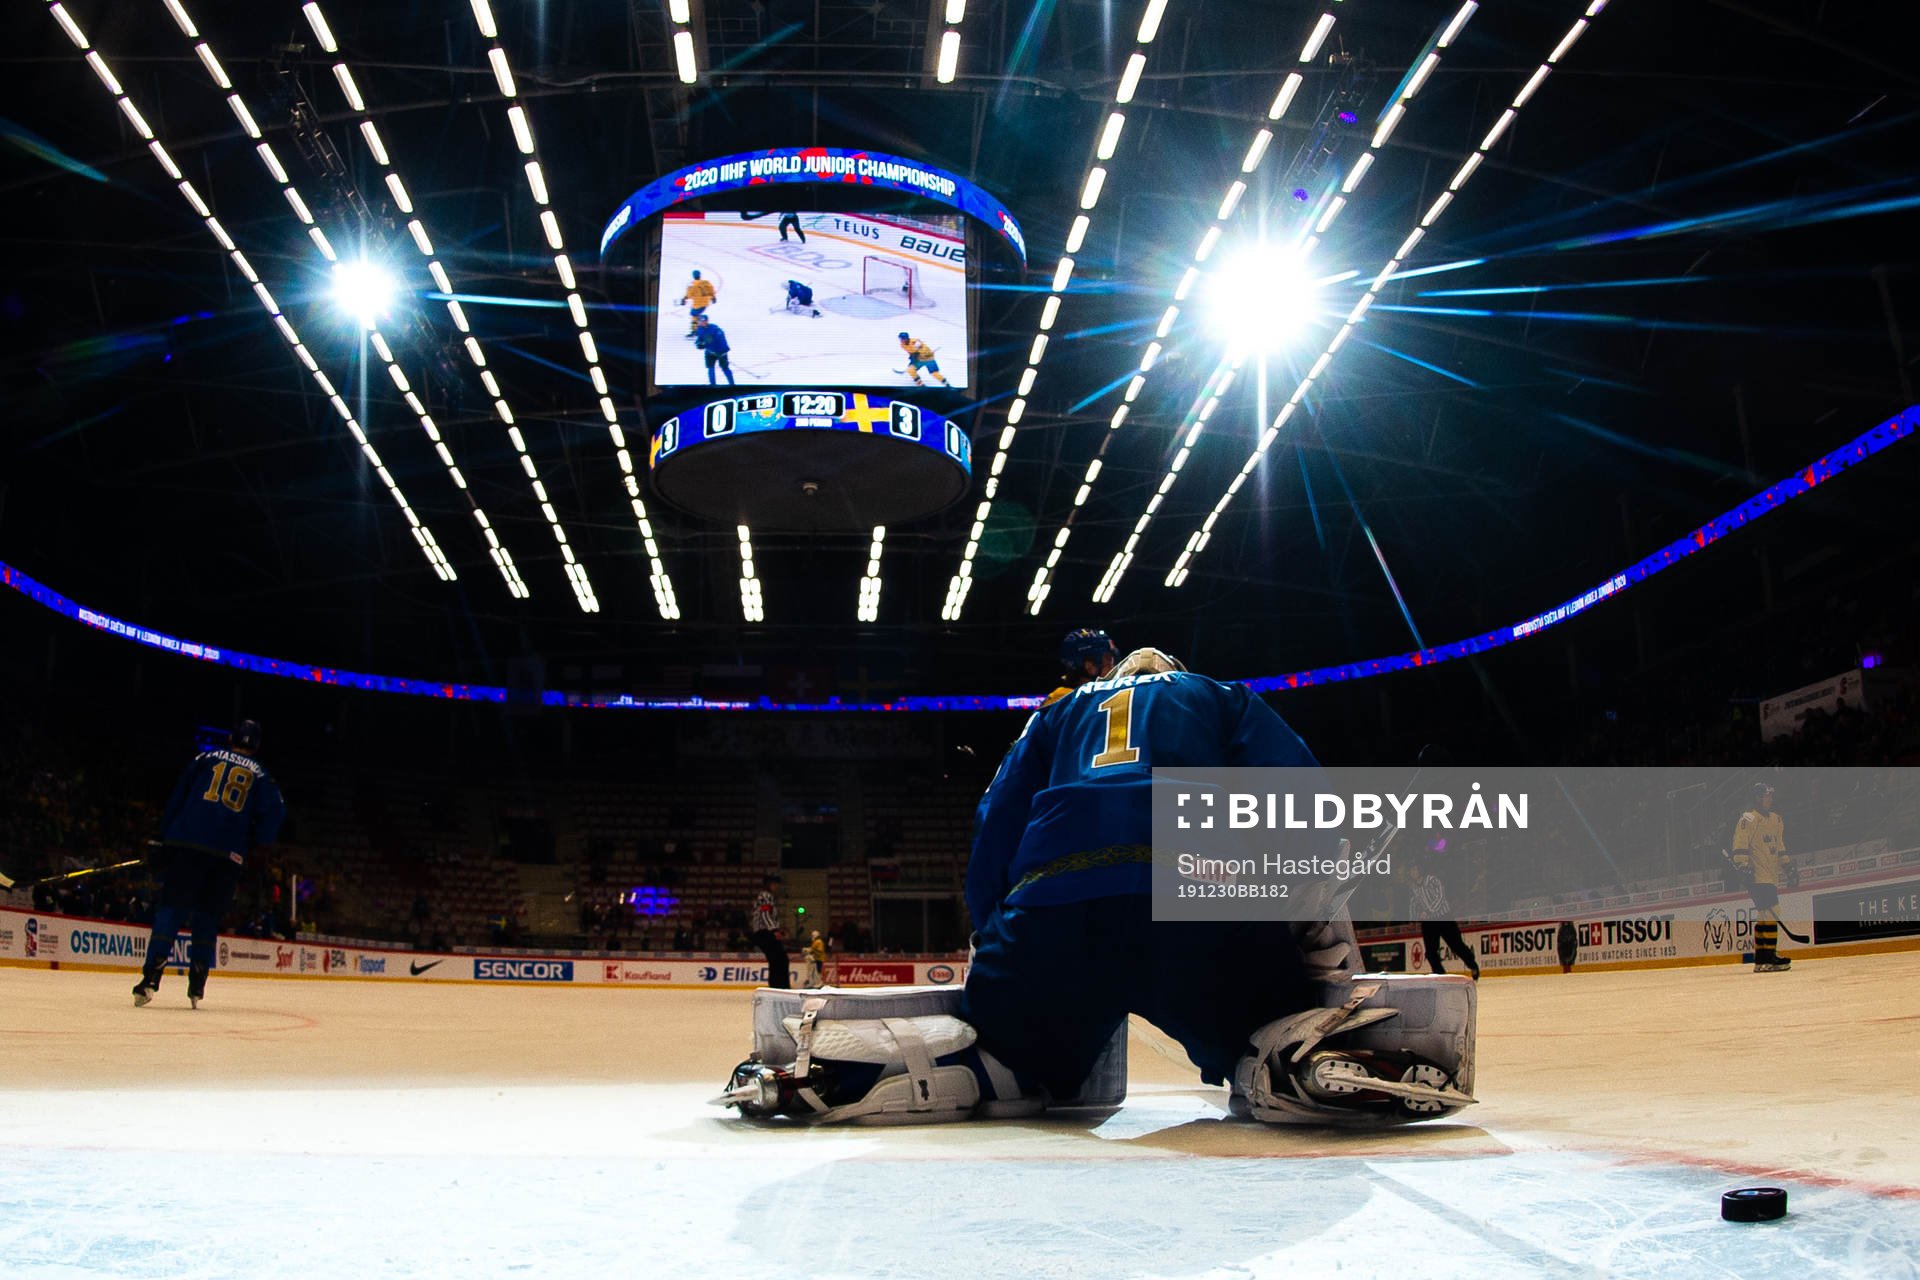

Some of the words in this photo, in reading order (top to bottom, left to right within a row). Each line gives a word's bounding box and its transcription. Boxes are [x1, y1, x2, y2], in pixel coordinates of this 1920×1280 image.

[684, 166, 718, 192] 2020
[720, 161, 748, 182] IIHF
[749, 156, 801, 177] WORLD
[803, 156, 856, 175] JUNIOR
[858, 157, 956, 197] CHAMPIONSHIP
[833, 218, 880, 240] TELUS
[900, 235, 966, 263] Baue
[712, 404, 727, 432] 0
[792, 395, 836, 416] 12:20
[899, 406, 914, 435] 3
[1091, 687, 1140, 768] 1
[203, 761, 255, 813] 18
[1859, 899, 1889, 916] THE
[1898, 894, 1918, 911] KE
[1501, 928, 1556, 953] TISSOT
[1603, 914, 1675, 945] TISSOT
[70, 930, 146, 958] OSTRAVA!!!
[1601, 949, 1633, 960] WATCHES
[1636, 947, 1657, 958] SINCE
[478, 962, 564, 980] SENCOR
[722, 966, 798, 982] EllisDn
